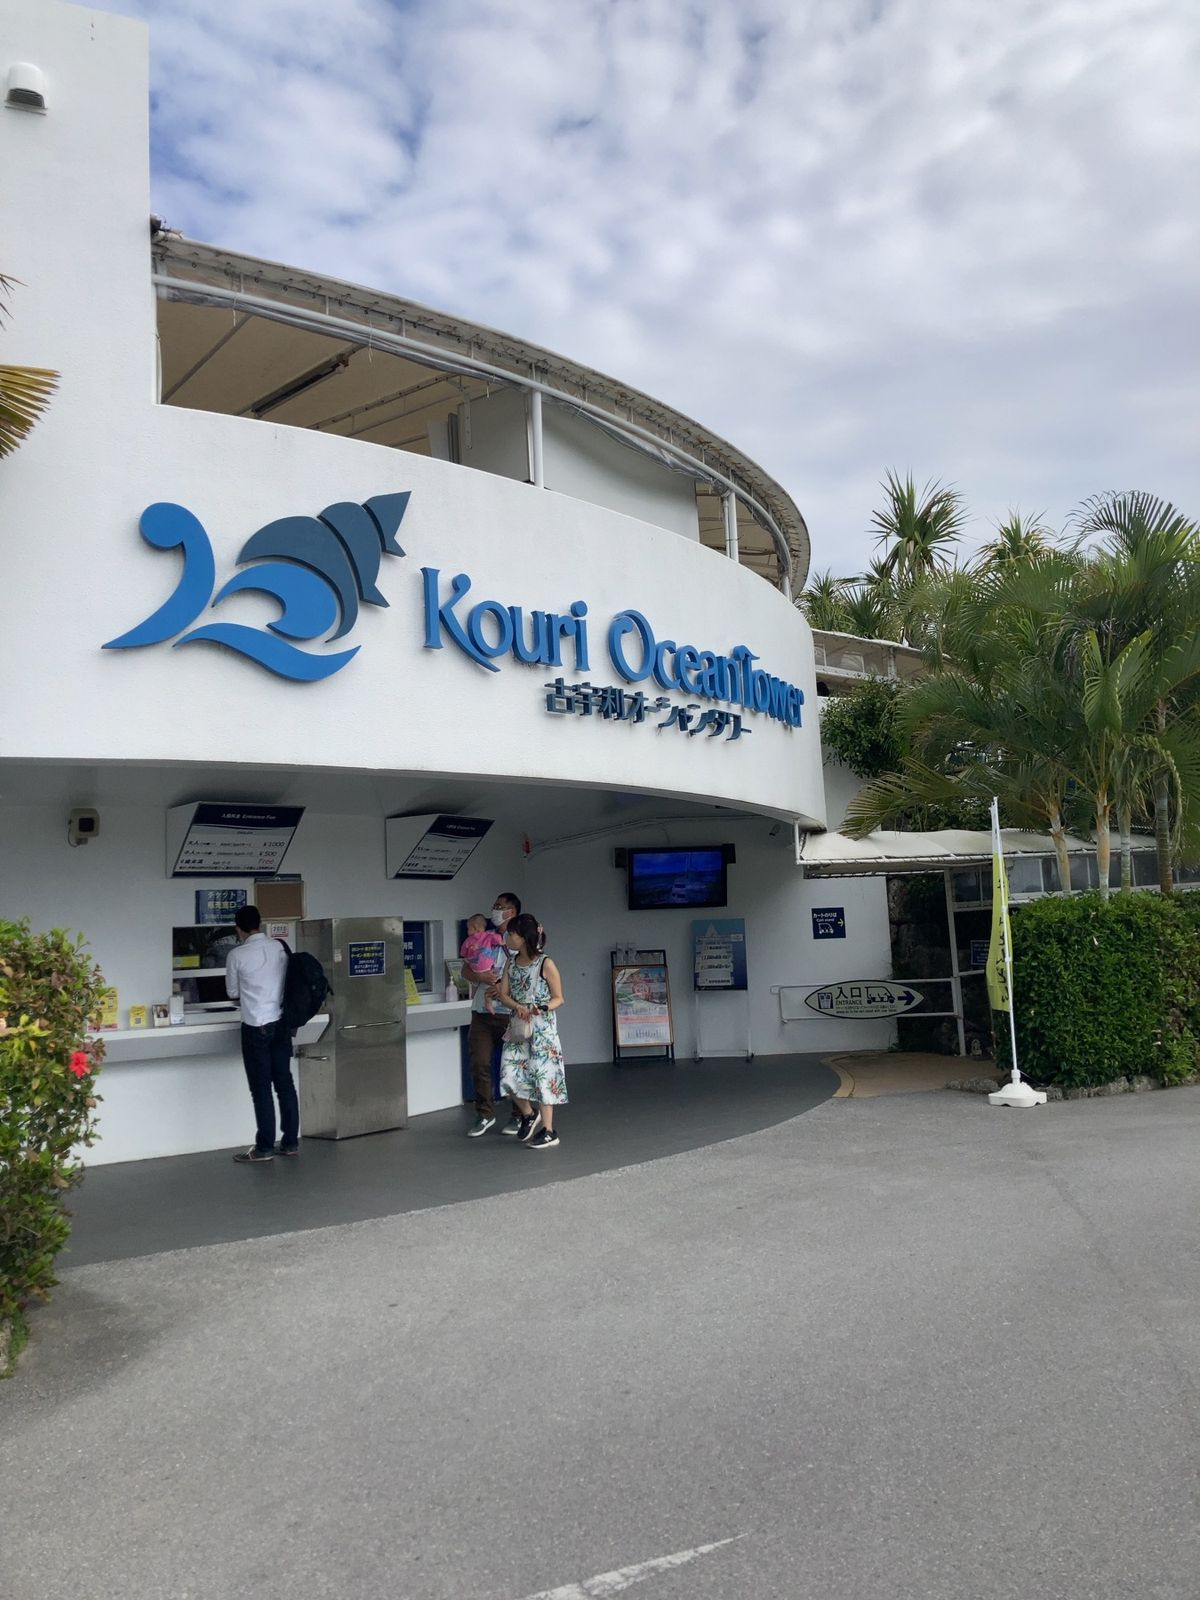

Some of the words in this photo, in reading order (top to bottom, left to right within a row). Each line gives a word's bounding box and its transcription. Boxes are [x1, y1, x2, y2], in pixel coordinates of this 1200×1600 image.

[420, 566, 591, 672] Kouri
[544, 676, 752, 742] 古宇利オーシャンタワー
[835, 986, 862, 1000] 入口
